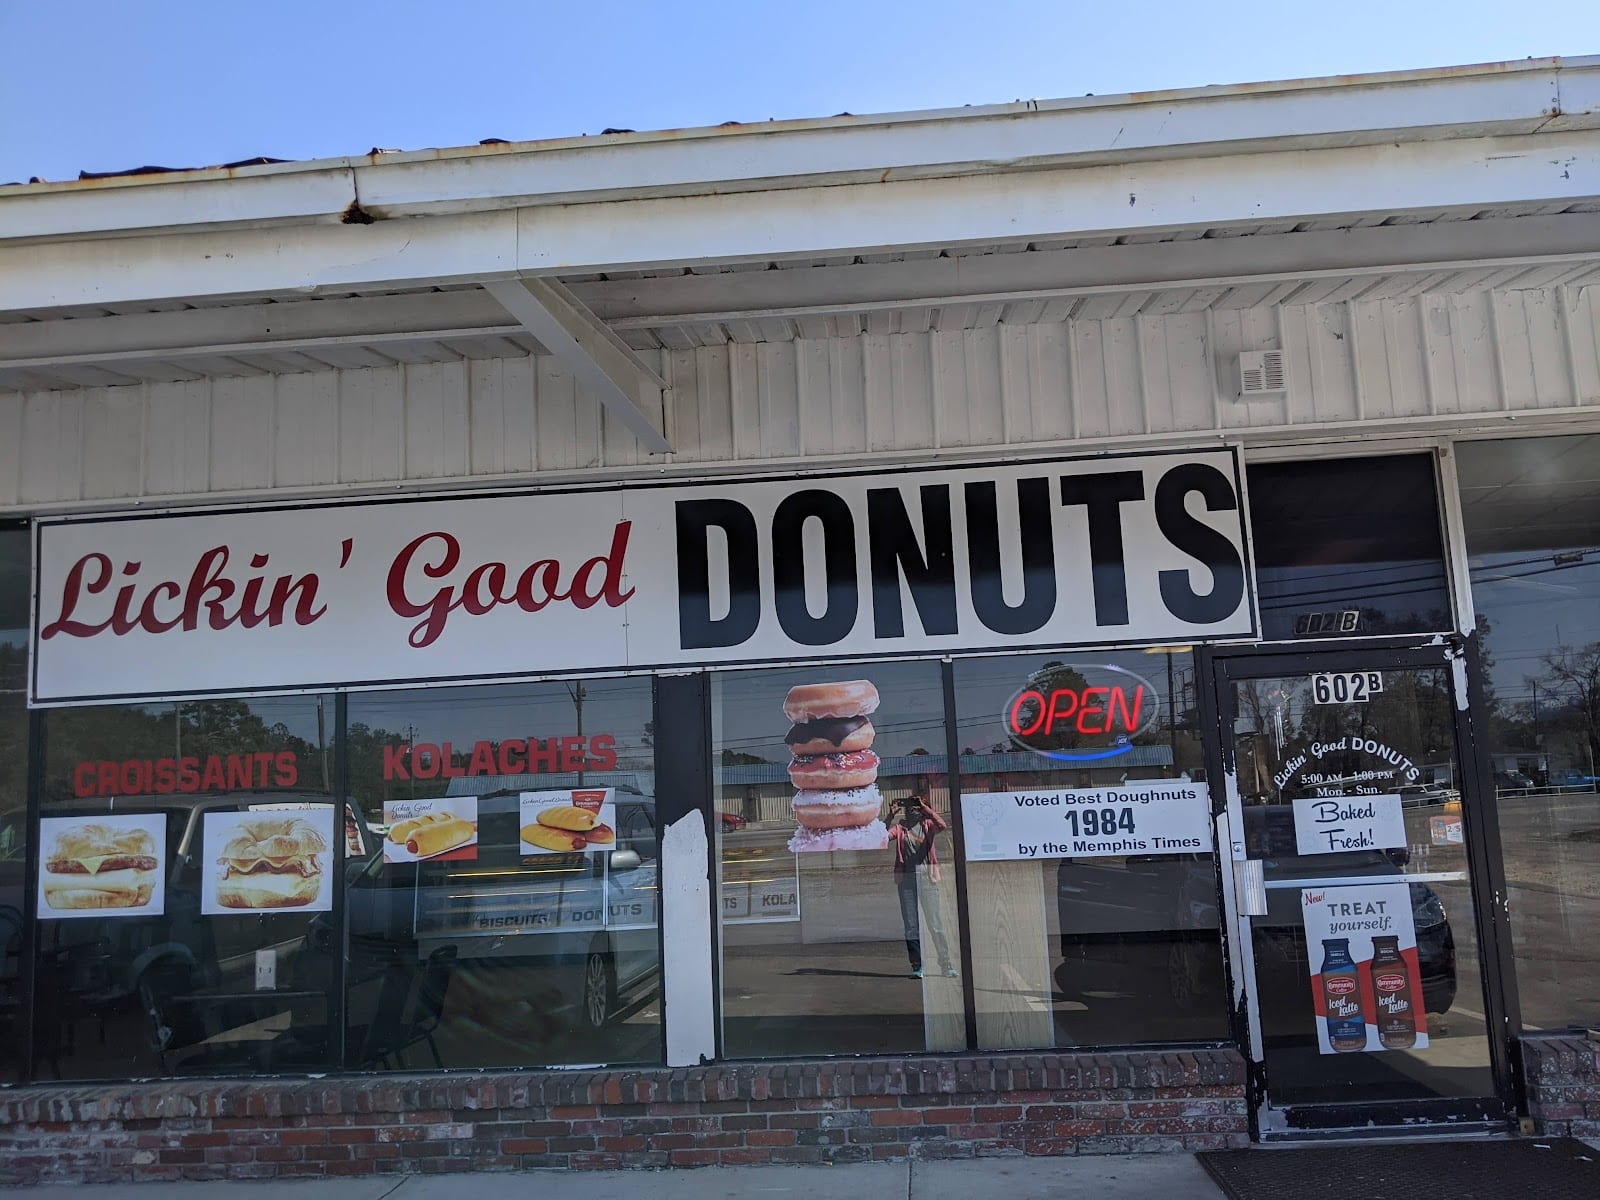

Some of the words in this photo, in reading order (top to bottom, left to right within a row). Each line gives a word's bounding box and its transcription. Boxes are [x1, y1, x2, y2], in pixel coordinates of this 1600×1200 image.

[41, 538, 353, 640] Lickin'
[386, 521, 636, 648] Good
[674, 463, 1244, 650] DONUTS
[1010, 684, 1144, 736] OPEN
[383, 734, 618, 780] KOLACHES
[1311, 737, 1347, 759] Good
[1351, 737, 1420, 781] DONUTS
[74, 751, 298, 797] CROISSANTS
[1301, 773, 1323, 784] 5:00
[1326, 774, 1343, 783] AM
[1377, 770, 1394, 780] PM
[1014, 794, 1060, 807] Voted
[1065, 792, 1102, 805] Best
[1107, 788, 1197, 805] Doughnuts
[1356, 785, 1383, 795] Sun.
[1311, 801, 1376, 823] Baked
[1064, 807, 1136, 837] 1984
[1018, 843, 1038, 858] by
[1043, 841, 1068, 854] the
[1073, 838, 1147, 855] Memphis
[1151, 836, 1201, 850] Times
[1319, 828, 1375, 851] Fresh!
[1305, 891, 1326, 906] New!
[1327, 901, 1387, 917] TREAT
[1329, 916, 1392, 934] yourself.
[1328, 996, 1346, 1009] Iced
[1378, 993, 1396, 1006] Iced
[1388, 999, 1409, 1014] Latte
[1338, 1003, 1359, 1017] Latte
